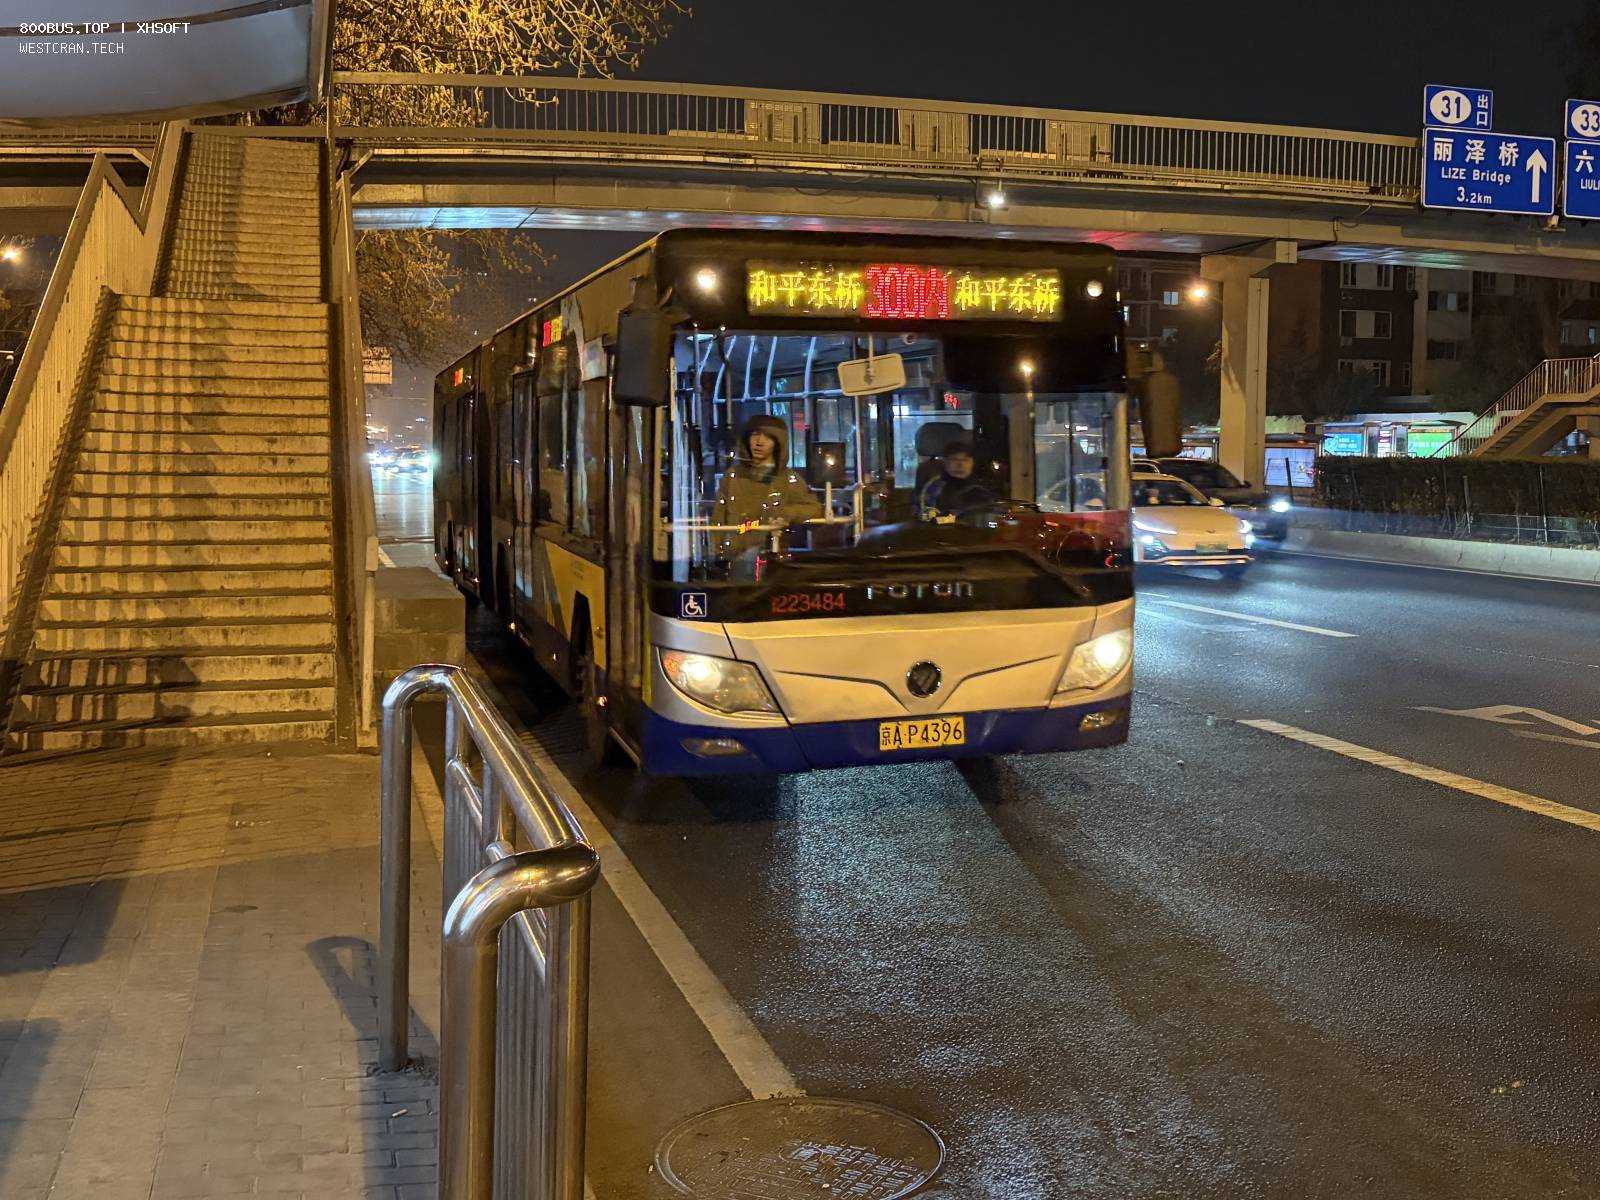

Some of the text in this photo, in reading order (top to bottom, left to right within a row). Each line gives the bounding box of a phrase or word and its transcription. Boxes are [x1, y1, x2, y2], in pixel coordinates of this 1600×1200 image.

[1441, 95, 1462, 119] 31
[1476, 94, 1489, 127] 出口
[1580, 109, 1600, 132] 33
[1433, 137, 1520, 167] 丽泽桥
[1575, 149, 1595, 173] 六
[1441, 166, 1512, 186] LIZE Bridge
[1456, 186, 1493, 205] 3.2km
[748, 270, 864, 310] 和平东桥
[866, 266, 949, 318] 300内
[954, 273, 1060, 314] 和平东桥
